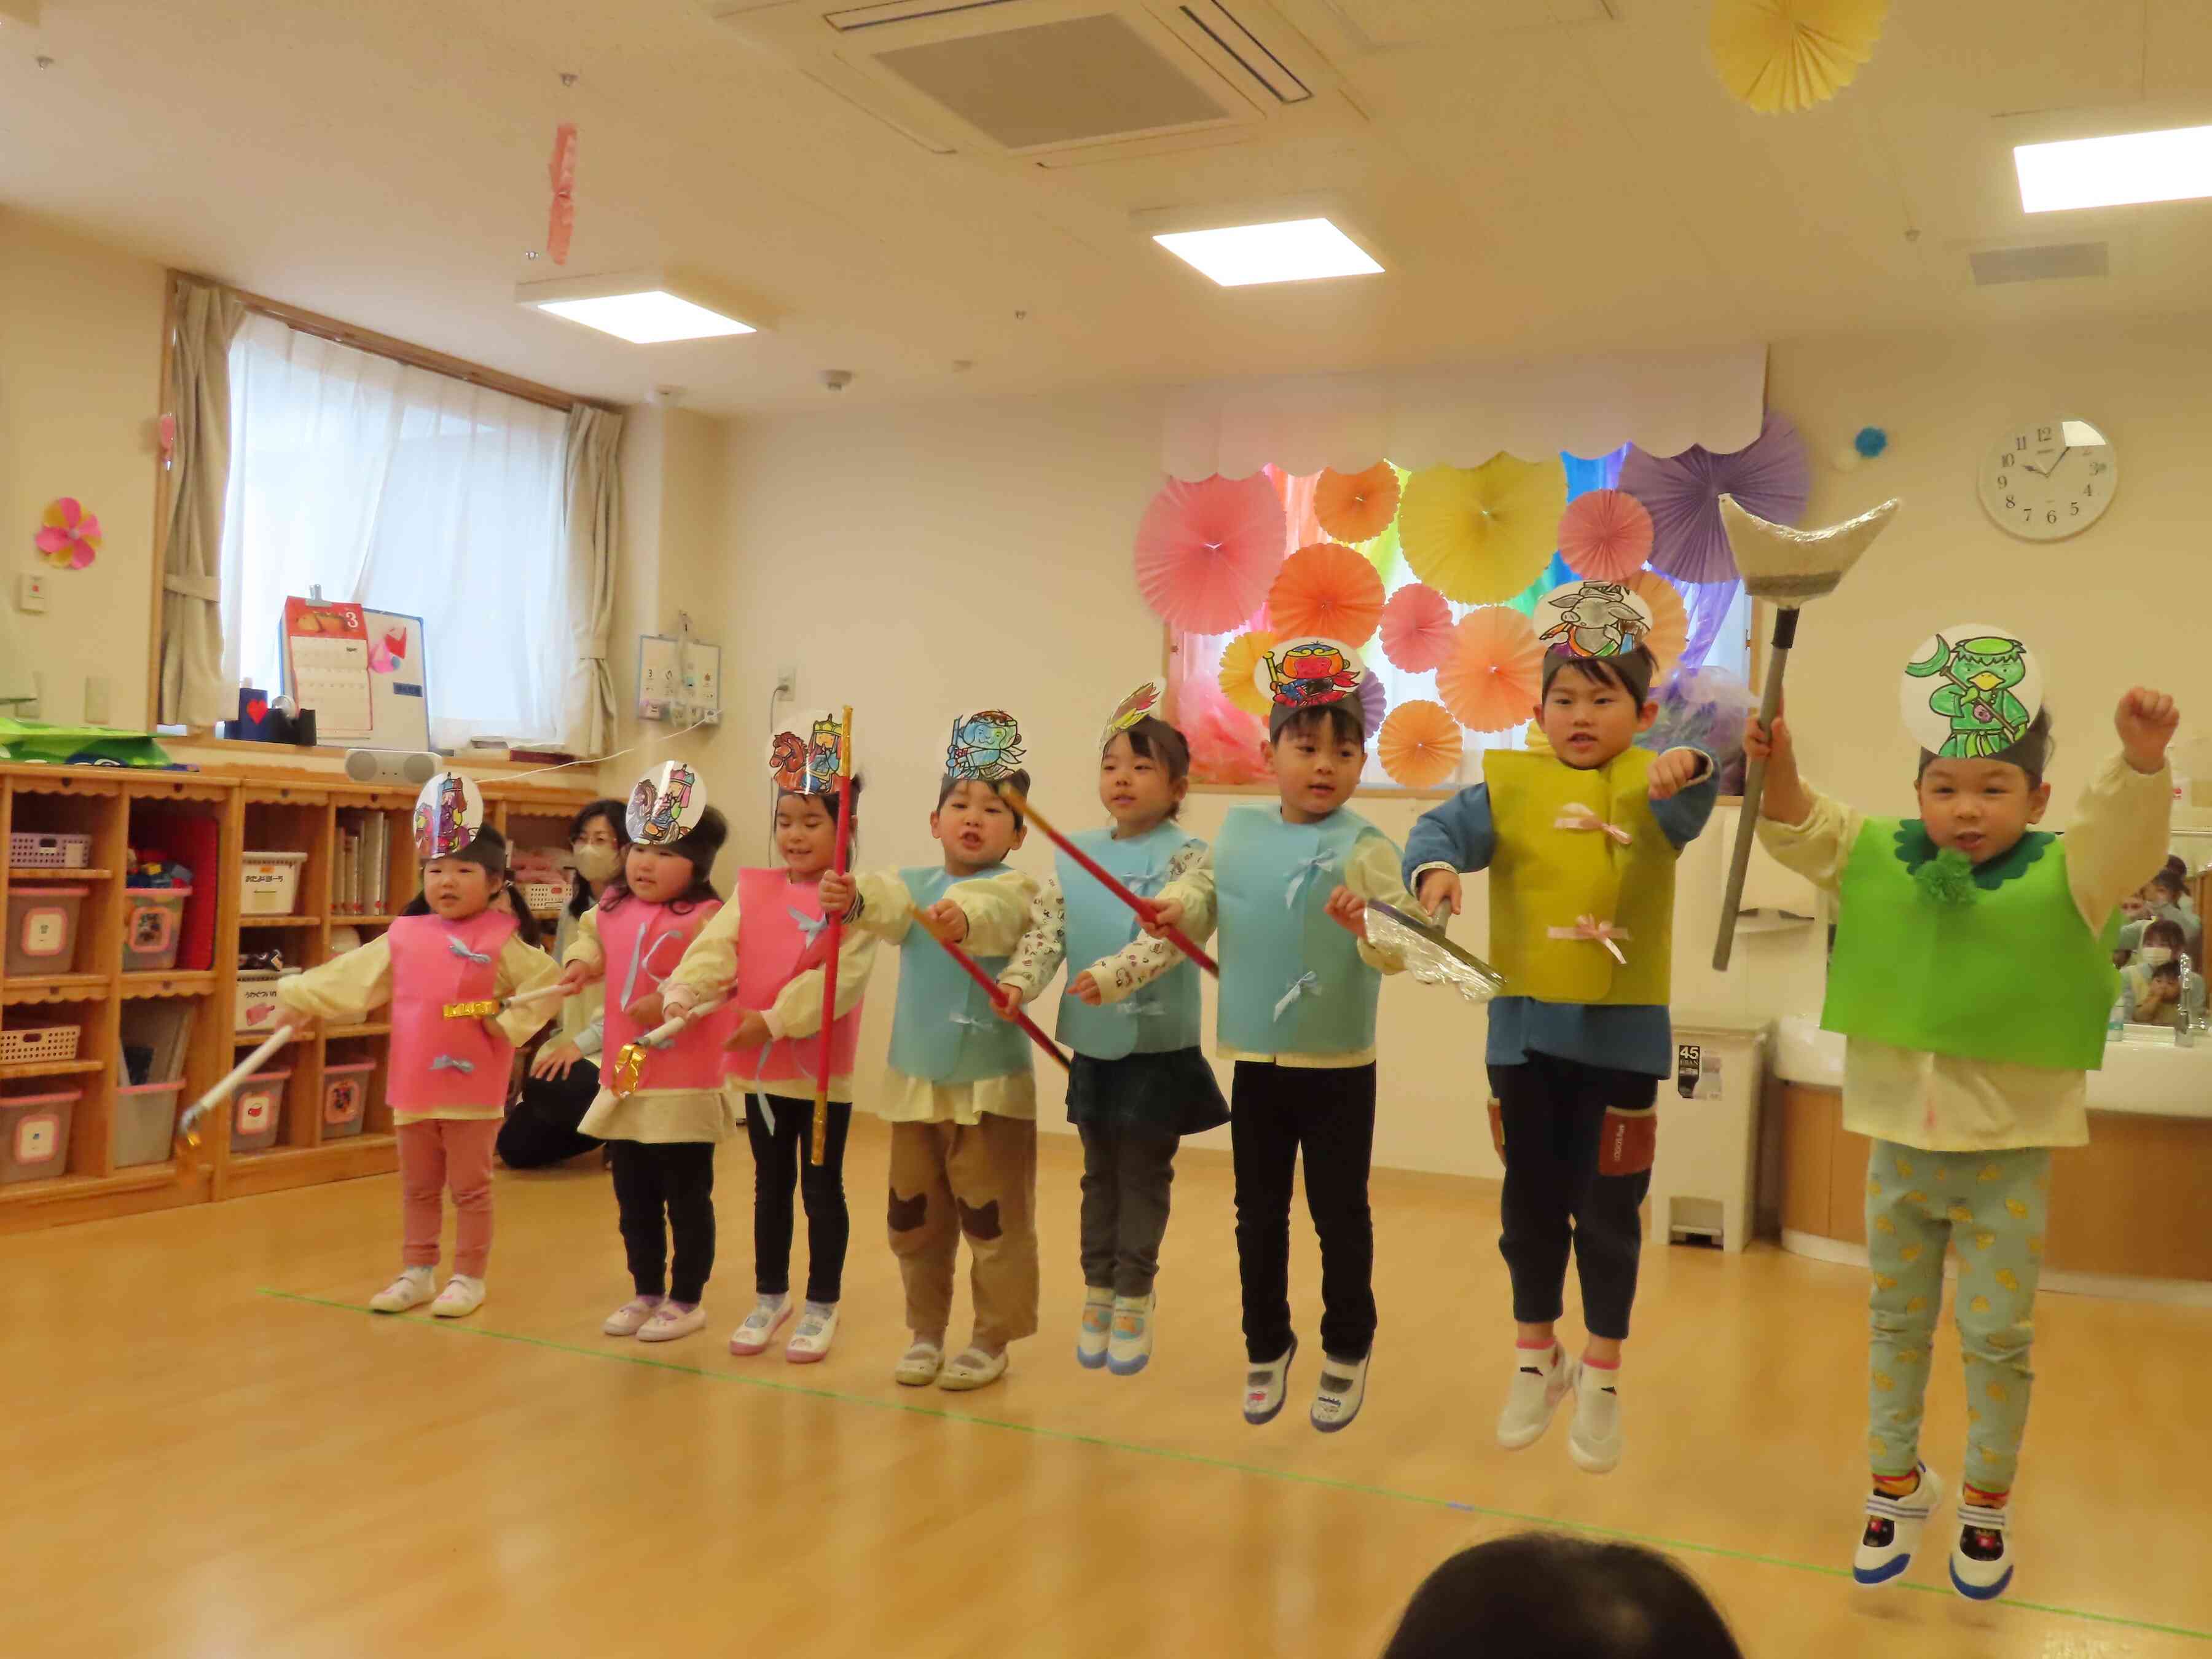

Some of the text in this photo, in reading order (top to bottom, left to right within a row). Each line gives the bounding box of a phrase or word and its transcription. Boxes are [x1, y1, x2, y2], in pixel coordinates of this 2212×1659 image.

[2037, 427, 2052, 441] 12
[2016, 436, 2026, 450] 11
[2001, 453, 2015, 467] 10
[1998, 476, 2007, 489] 9
[2083, 484, 2093, 496] 4
[2006, 495, 2016, 509] 8
[2070, 501, 2079, 516] 5
[2023, 509, 2032, 521] 7
[2047, 510, 2057, 524] 6
[345, 611, 358, 628] 3
[1680, 1046, 1699, 1059] 45
